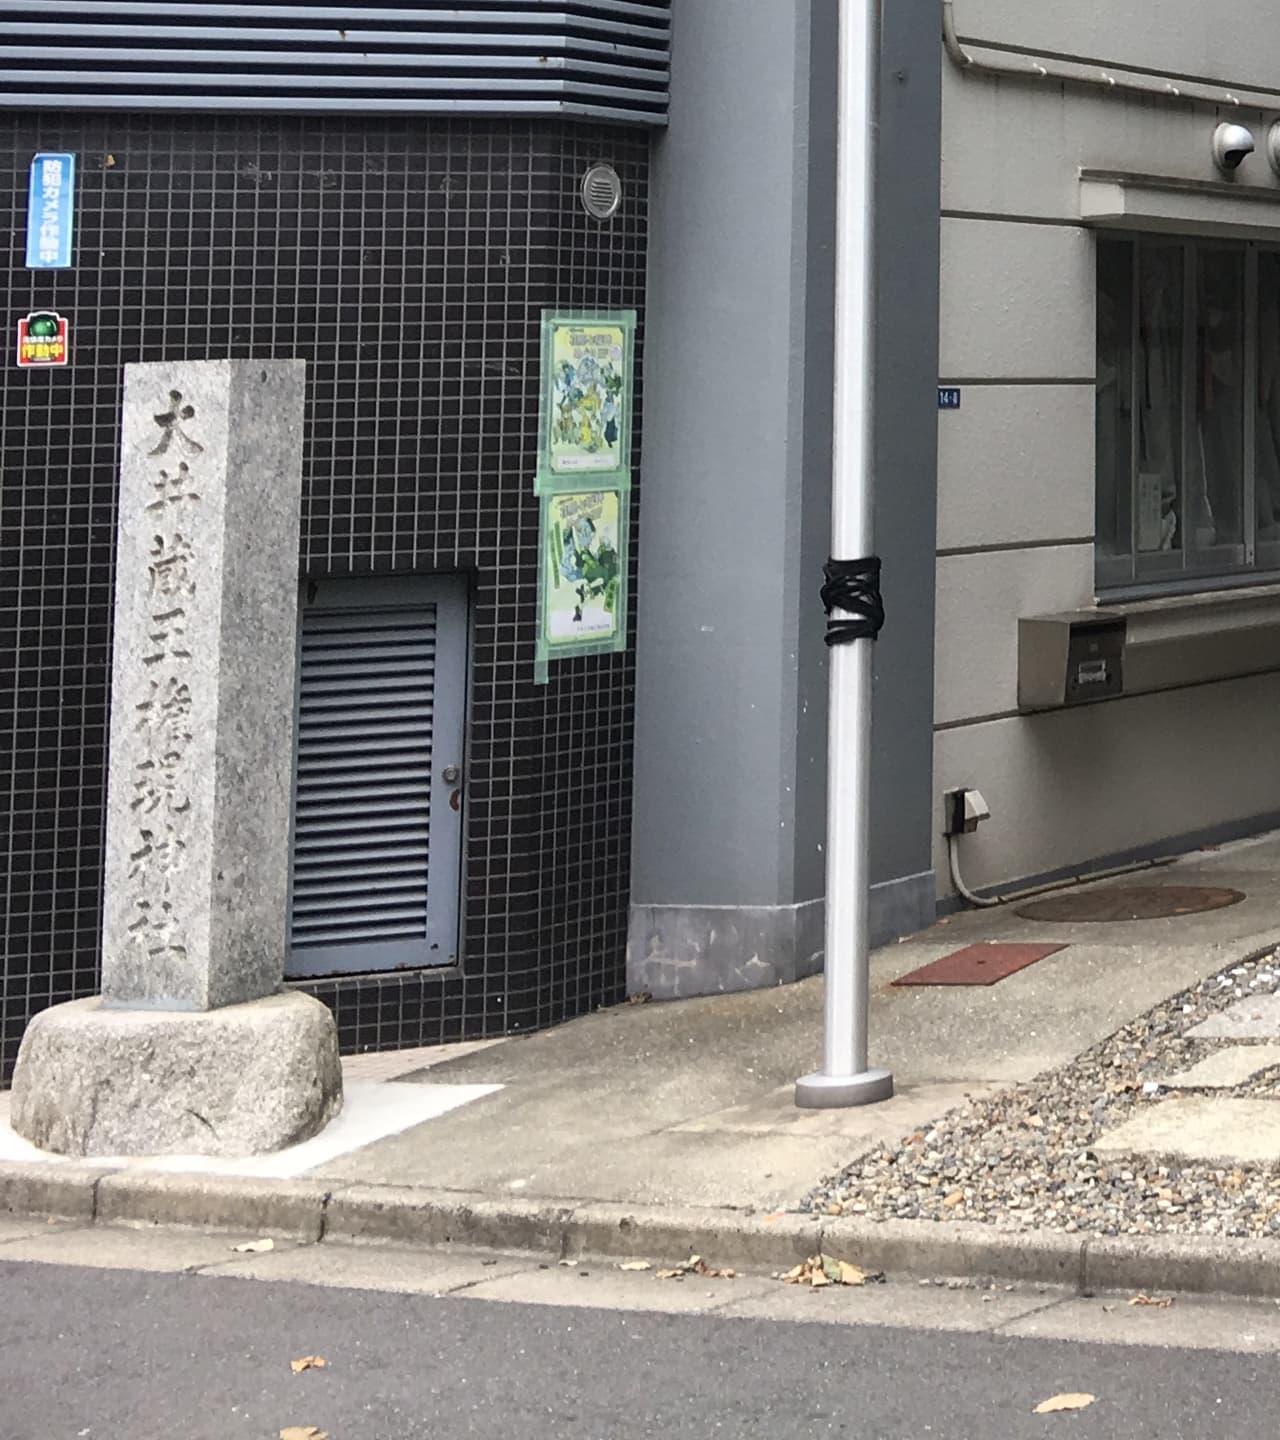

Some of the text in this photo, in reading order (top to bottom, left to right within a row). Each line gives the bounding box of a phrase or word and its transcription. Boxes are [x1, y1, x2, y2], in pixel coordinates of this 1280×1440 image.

[39, 159, 62, 263] 防犯カメラ作動中
[124, 389, 204, 961] 大井蔵王権現神社
